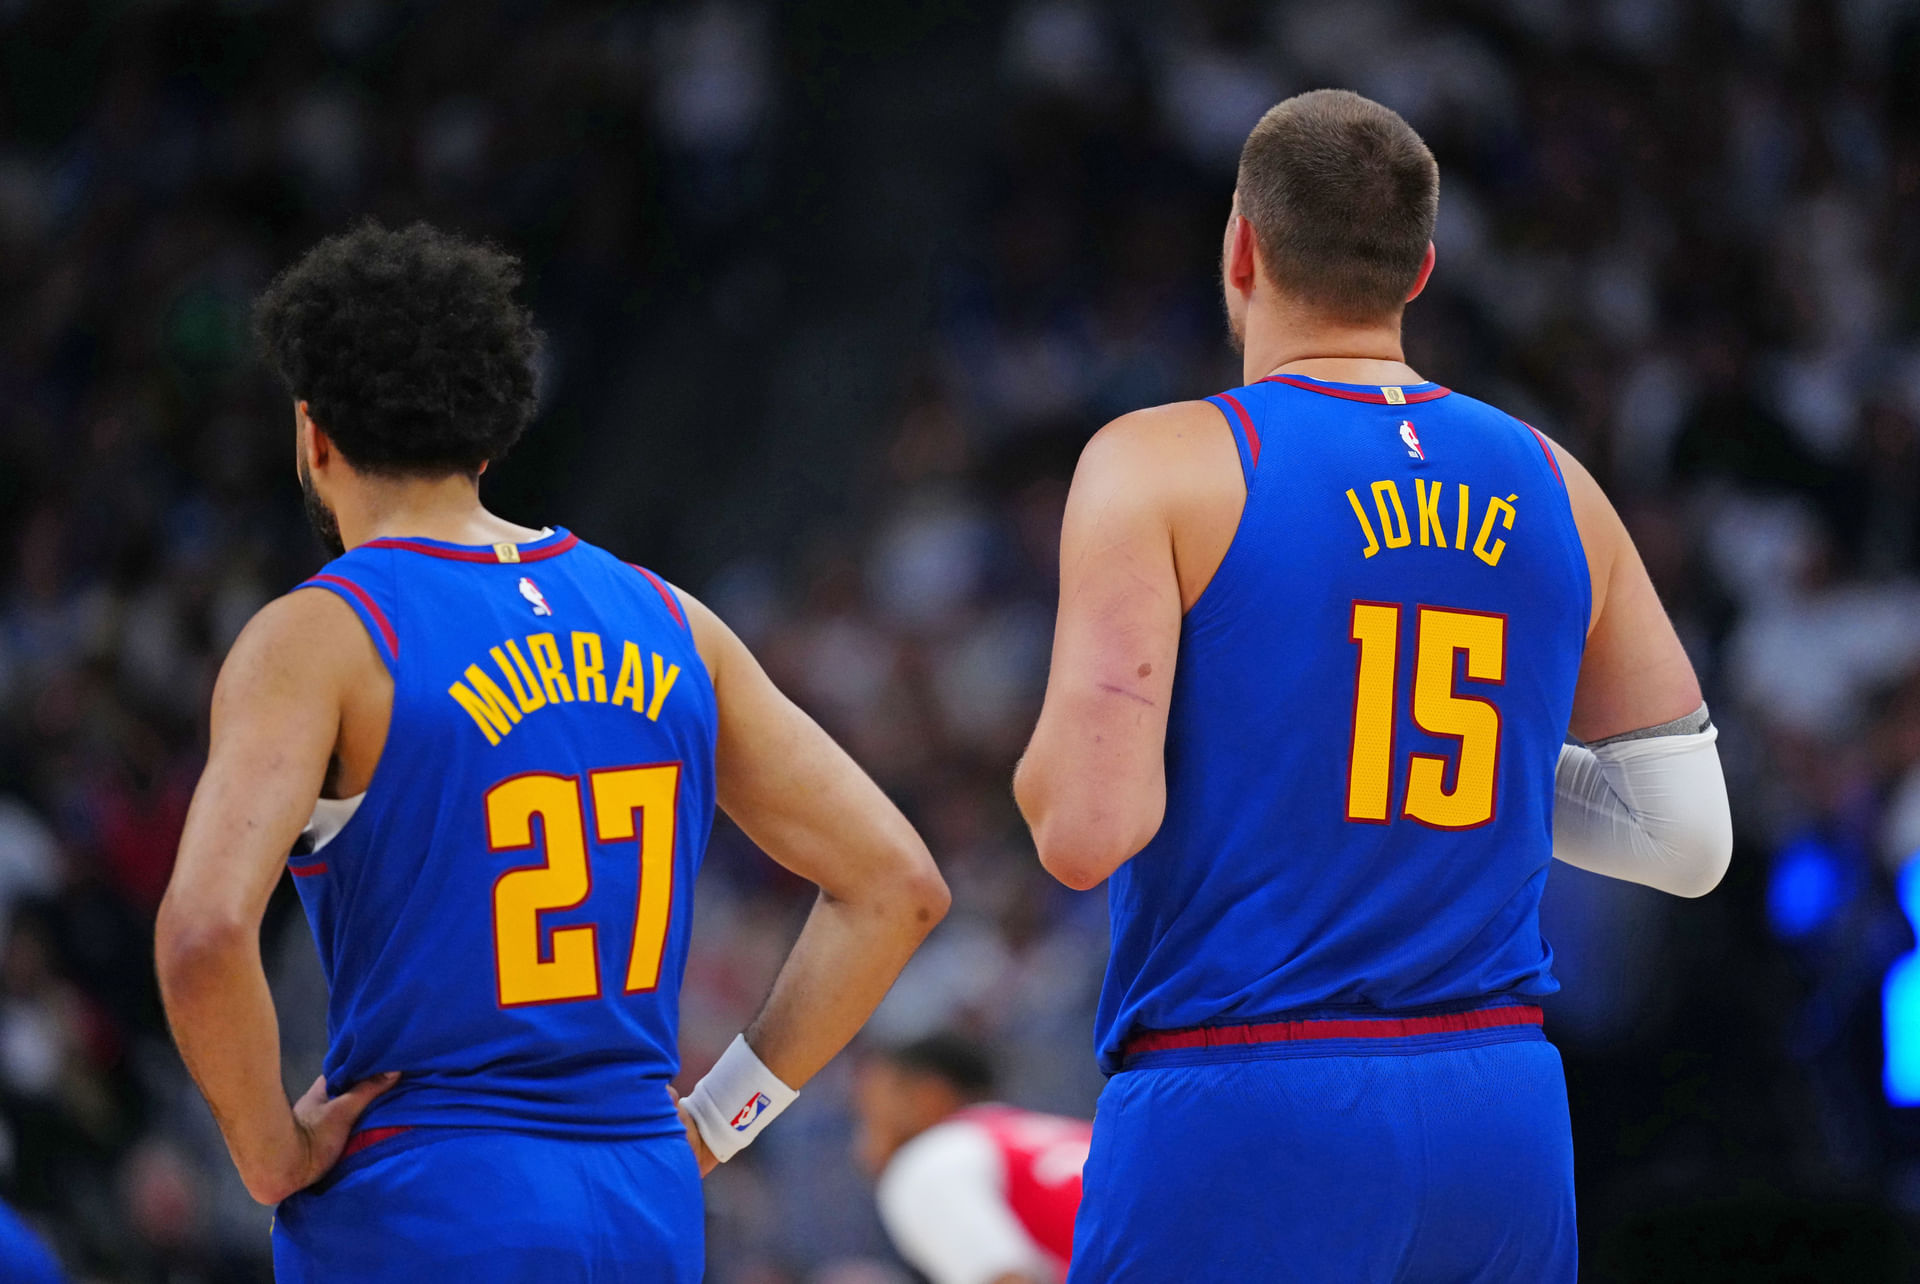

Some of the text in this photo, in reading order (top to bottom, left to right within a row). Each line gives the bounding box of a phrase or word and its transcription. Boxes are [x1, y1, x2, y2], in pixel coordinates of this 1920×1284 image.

[1346, 478, 1519, 567] JOKIĆ
[448, 631, 681, 747] MURRAY
[1346, 600, 1507, 831] 15
[484, 762, 682, 1008] 27
